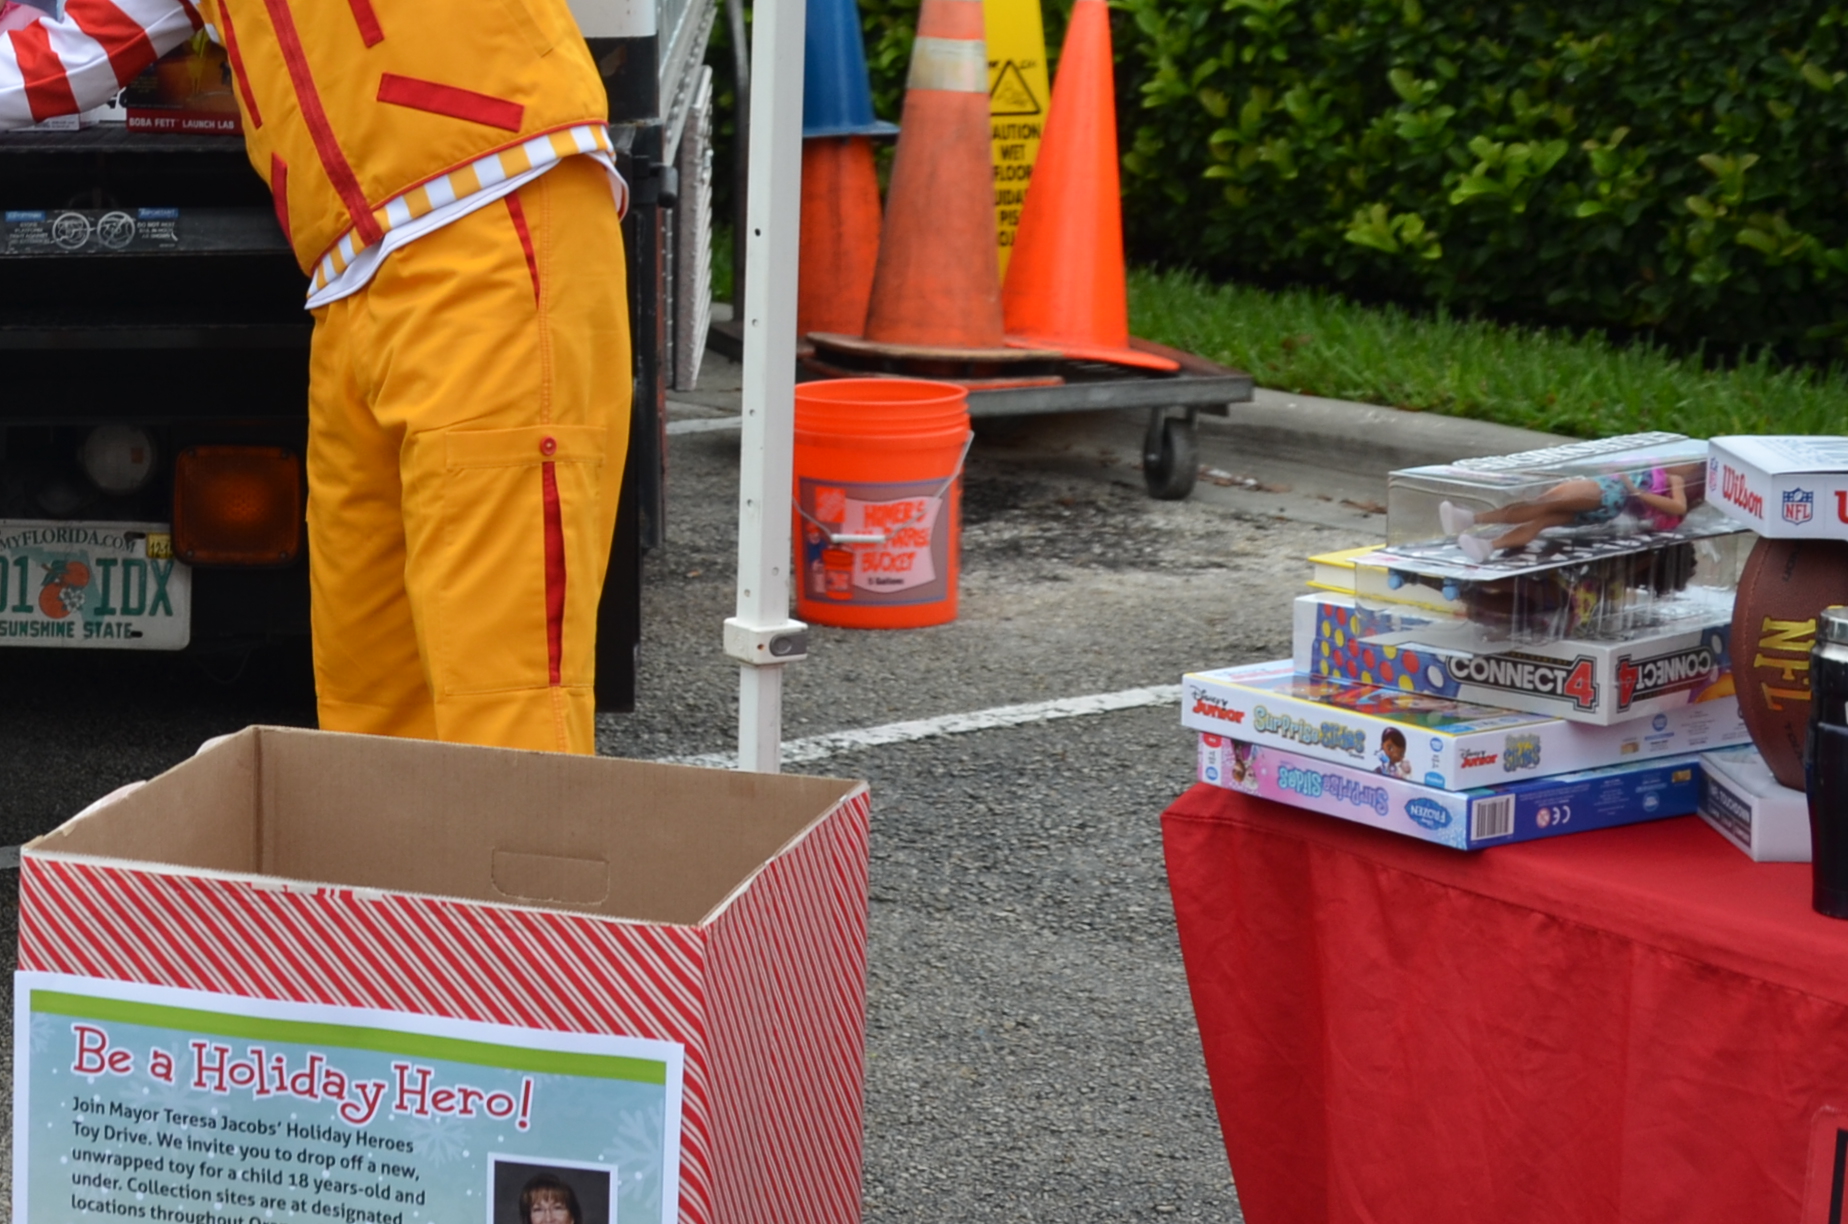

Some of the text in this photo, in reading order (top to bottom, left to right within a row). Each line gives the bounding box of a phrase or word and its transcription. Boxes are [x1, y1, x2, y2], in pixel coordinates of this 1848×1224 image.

[129, 118, 234, 129] BOBA FETT LAUNCH LAB
[993, 124, 1040, 140] AUTION
[1001, 145, 1025, 160] WET
[1722, 464, 1764, 520] Wilson
[1785, 504, 1810, 520] NFL
[0, 528, 137, 553] MYFLORIDA.COM
[861, 551, 916, 572] BUCKET
[94, 558, 174, 617] IDX
[83, 622, 132, 639] STATE
[1451, 657, 1594, 706] CONNECT 4
[1618, 649, 1712, 707] CONNECT 4
[1409, 804, 1447, 822] FROZEN
[73, 1026, 531, 1129] Be a Holiday Hero!
[73, 1096, 105, 1115] Join
[109, 1101, 159, 1124] Mayor
[164, 1109, 216, 1129] Teresa
[287, 1123, 352, 1147] Holiday
[356, 1131, 414, 1153] Heroes
[73, 1121, 419, 1181] Toy Drive. We invite you to drop off a new,
[72, 1148, 425, 1205] unwrapped toy for a child 18 years-old and
[72, 1173, 402, 1223] under. Collection sites are at designated
[72, 1194, 145, 1218] locations
